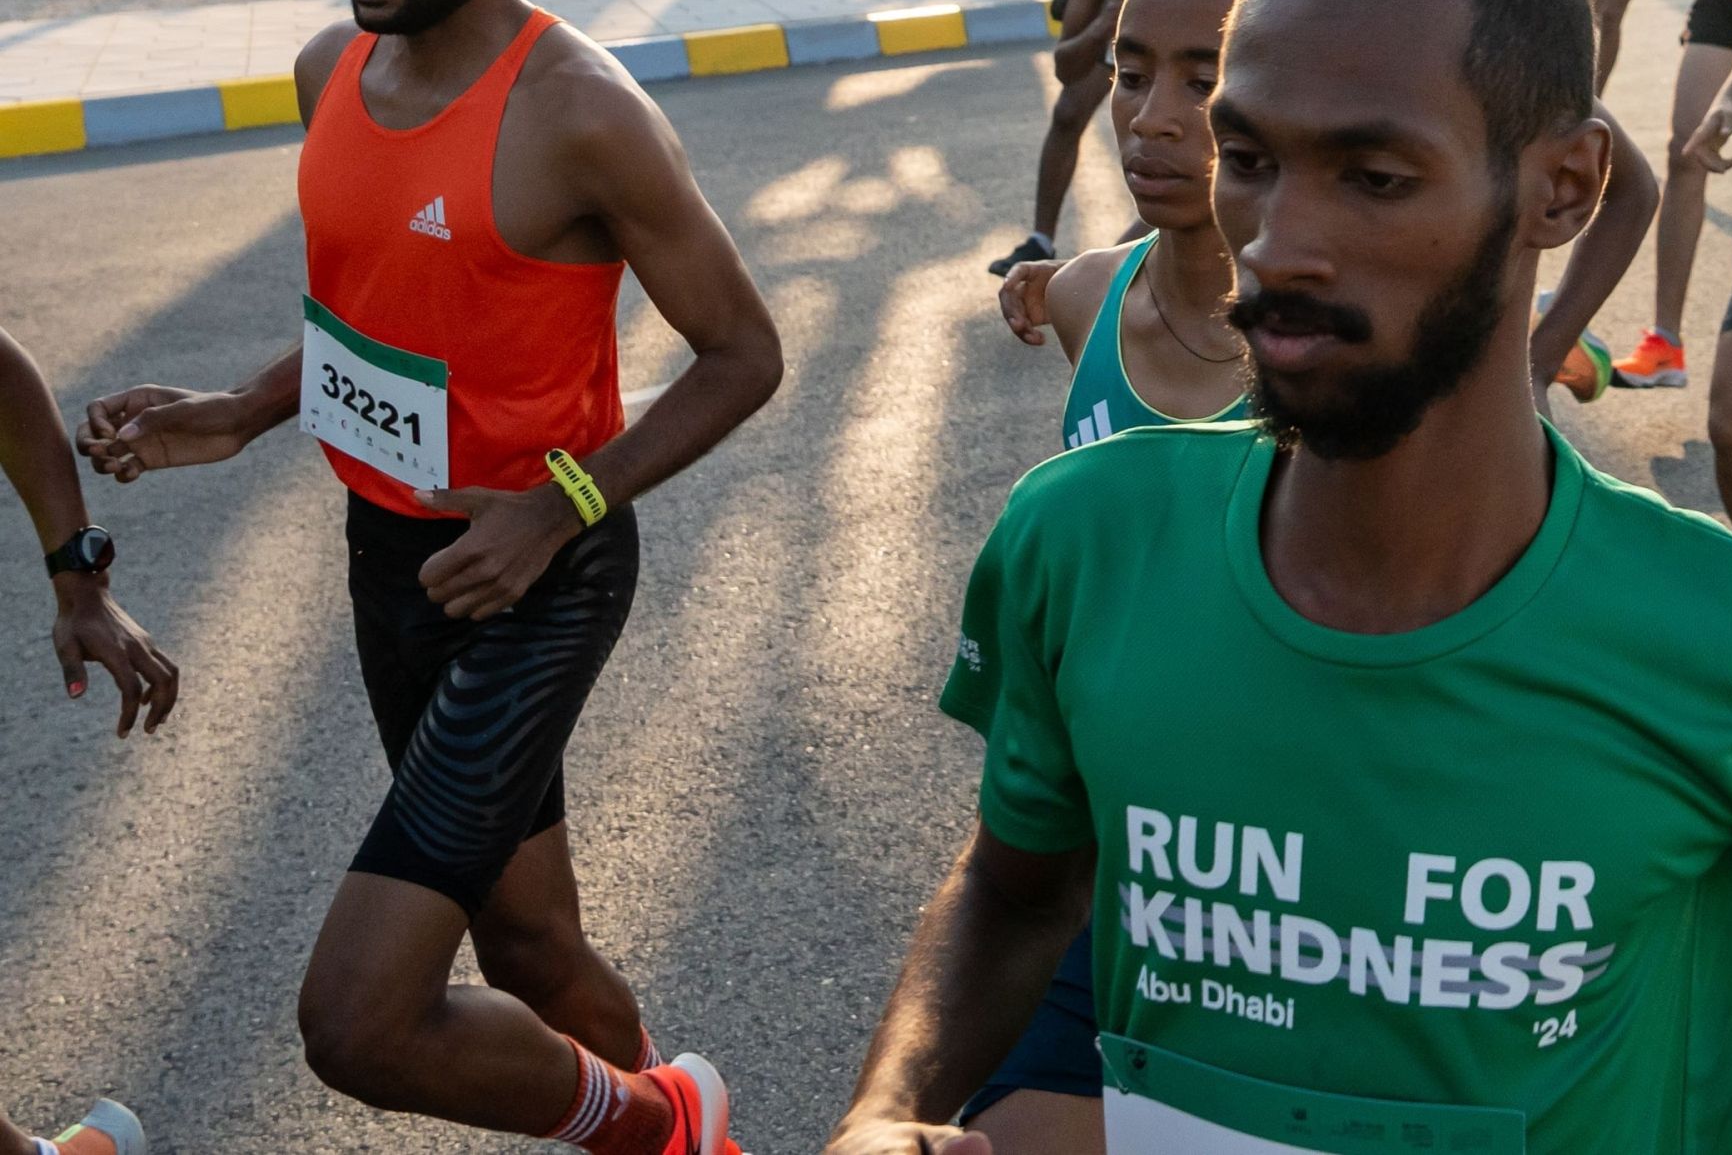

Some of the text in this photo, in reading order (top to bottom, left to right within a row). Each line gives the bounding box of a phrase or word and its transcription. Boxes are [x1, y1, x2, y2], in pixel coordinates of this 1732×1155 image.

[409, 218, 451, 241] adidas
[321, 363, 421, 446] 32221
[1126, 805, 1595, 932] RUN FOR
[1127, 882, 1588, 1010] KINDNESS
[1136, 965, 1294, 1029] Abu Dhabi
[1532, 1010, 1578, 1048] '24
